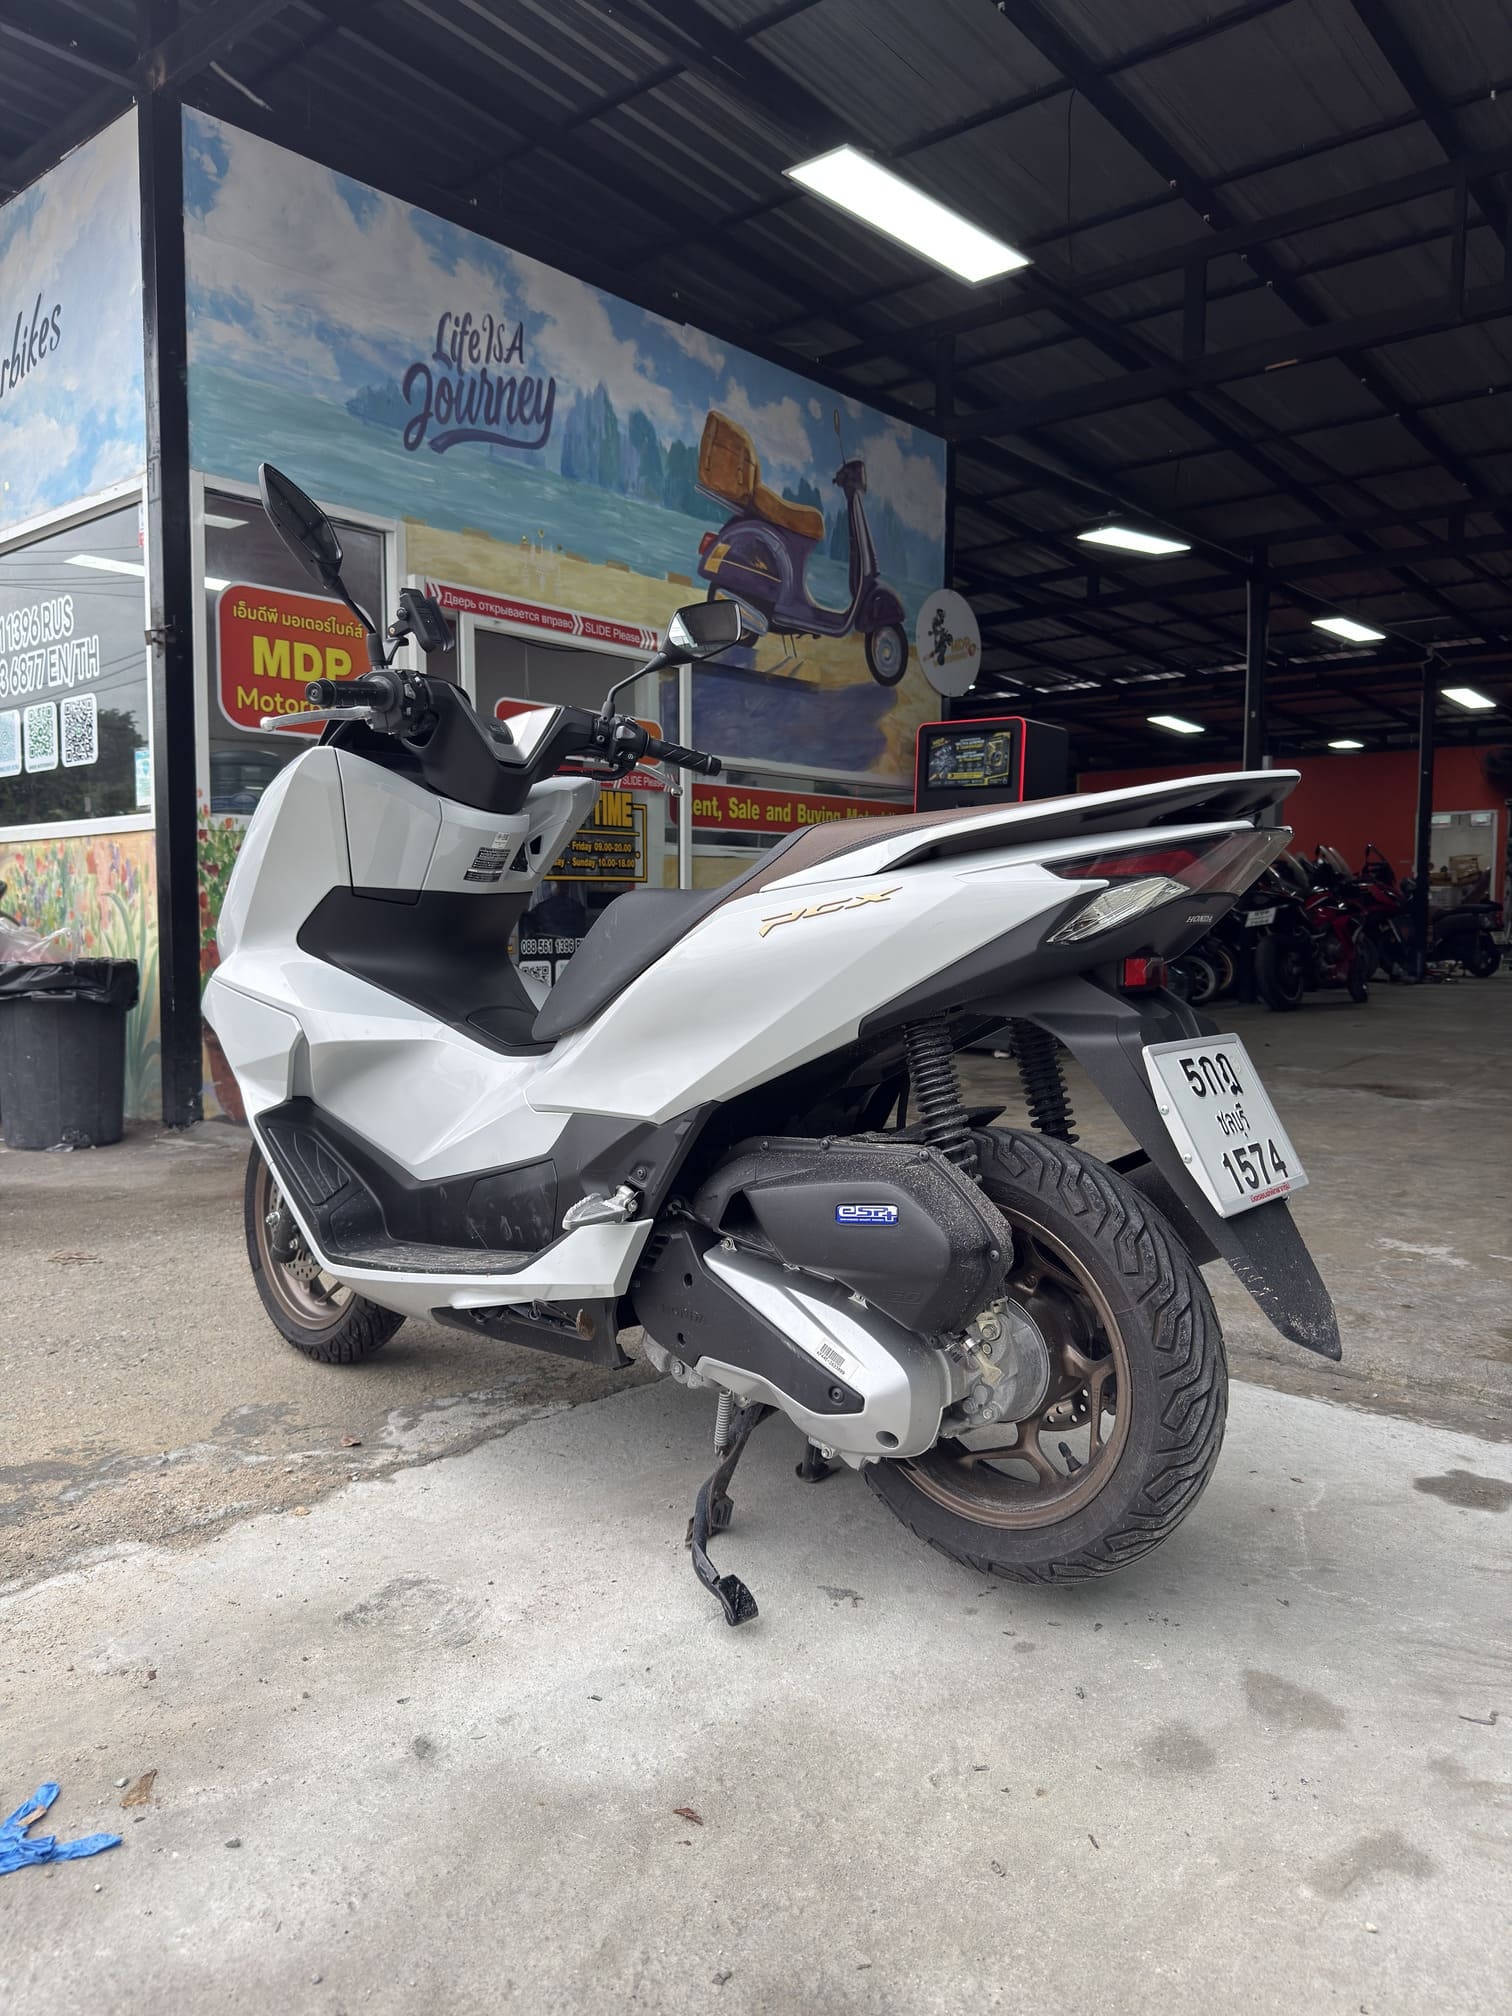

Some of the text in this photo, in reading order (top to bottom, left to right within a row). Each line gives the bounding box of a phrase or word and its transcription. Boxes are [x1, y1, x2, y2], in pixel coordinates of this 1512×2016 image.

[432, 312, 524, 376] Life Is A
[402, 362, 556, 454] Journey
[6, 605, 40, 651] 1396
[40, 594, 74, 642] RUS
[233, 600, 278, 624] เอ็มดีพี
[444, 592, 640, 644] Дверь открывается вправо SLIDE Please
[10, 649, 46, 695] 6877
[47, 634, 100, 687] EN/TH
[253, 635, 352, 681] MDP
[693, 796, 722, 822] ent,
[728, 797, 760, 820] Sale
[766, 803, 791, 822] and
[572, 841, 592, 853] Friday
[572, 857, 595, 869] Sunday
[759, 886, 903, 938] PCX
[538, 939, 554, 954] 561
[1217, 1103, 1250, 1138] ชลบุรี
[1222, 1139, 1289, 1194] 1574
